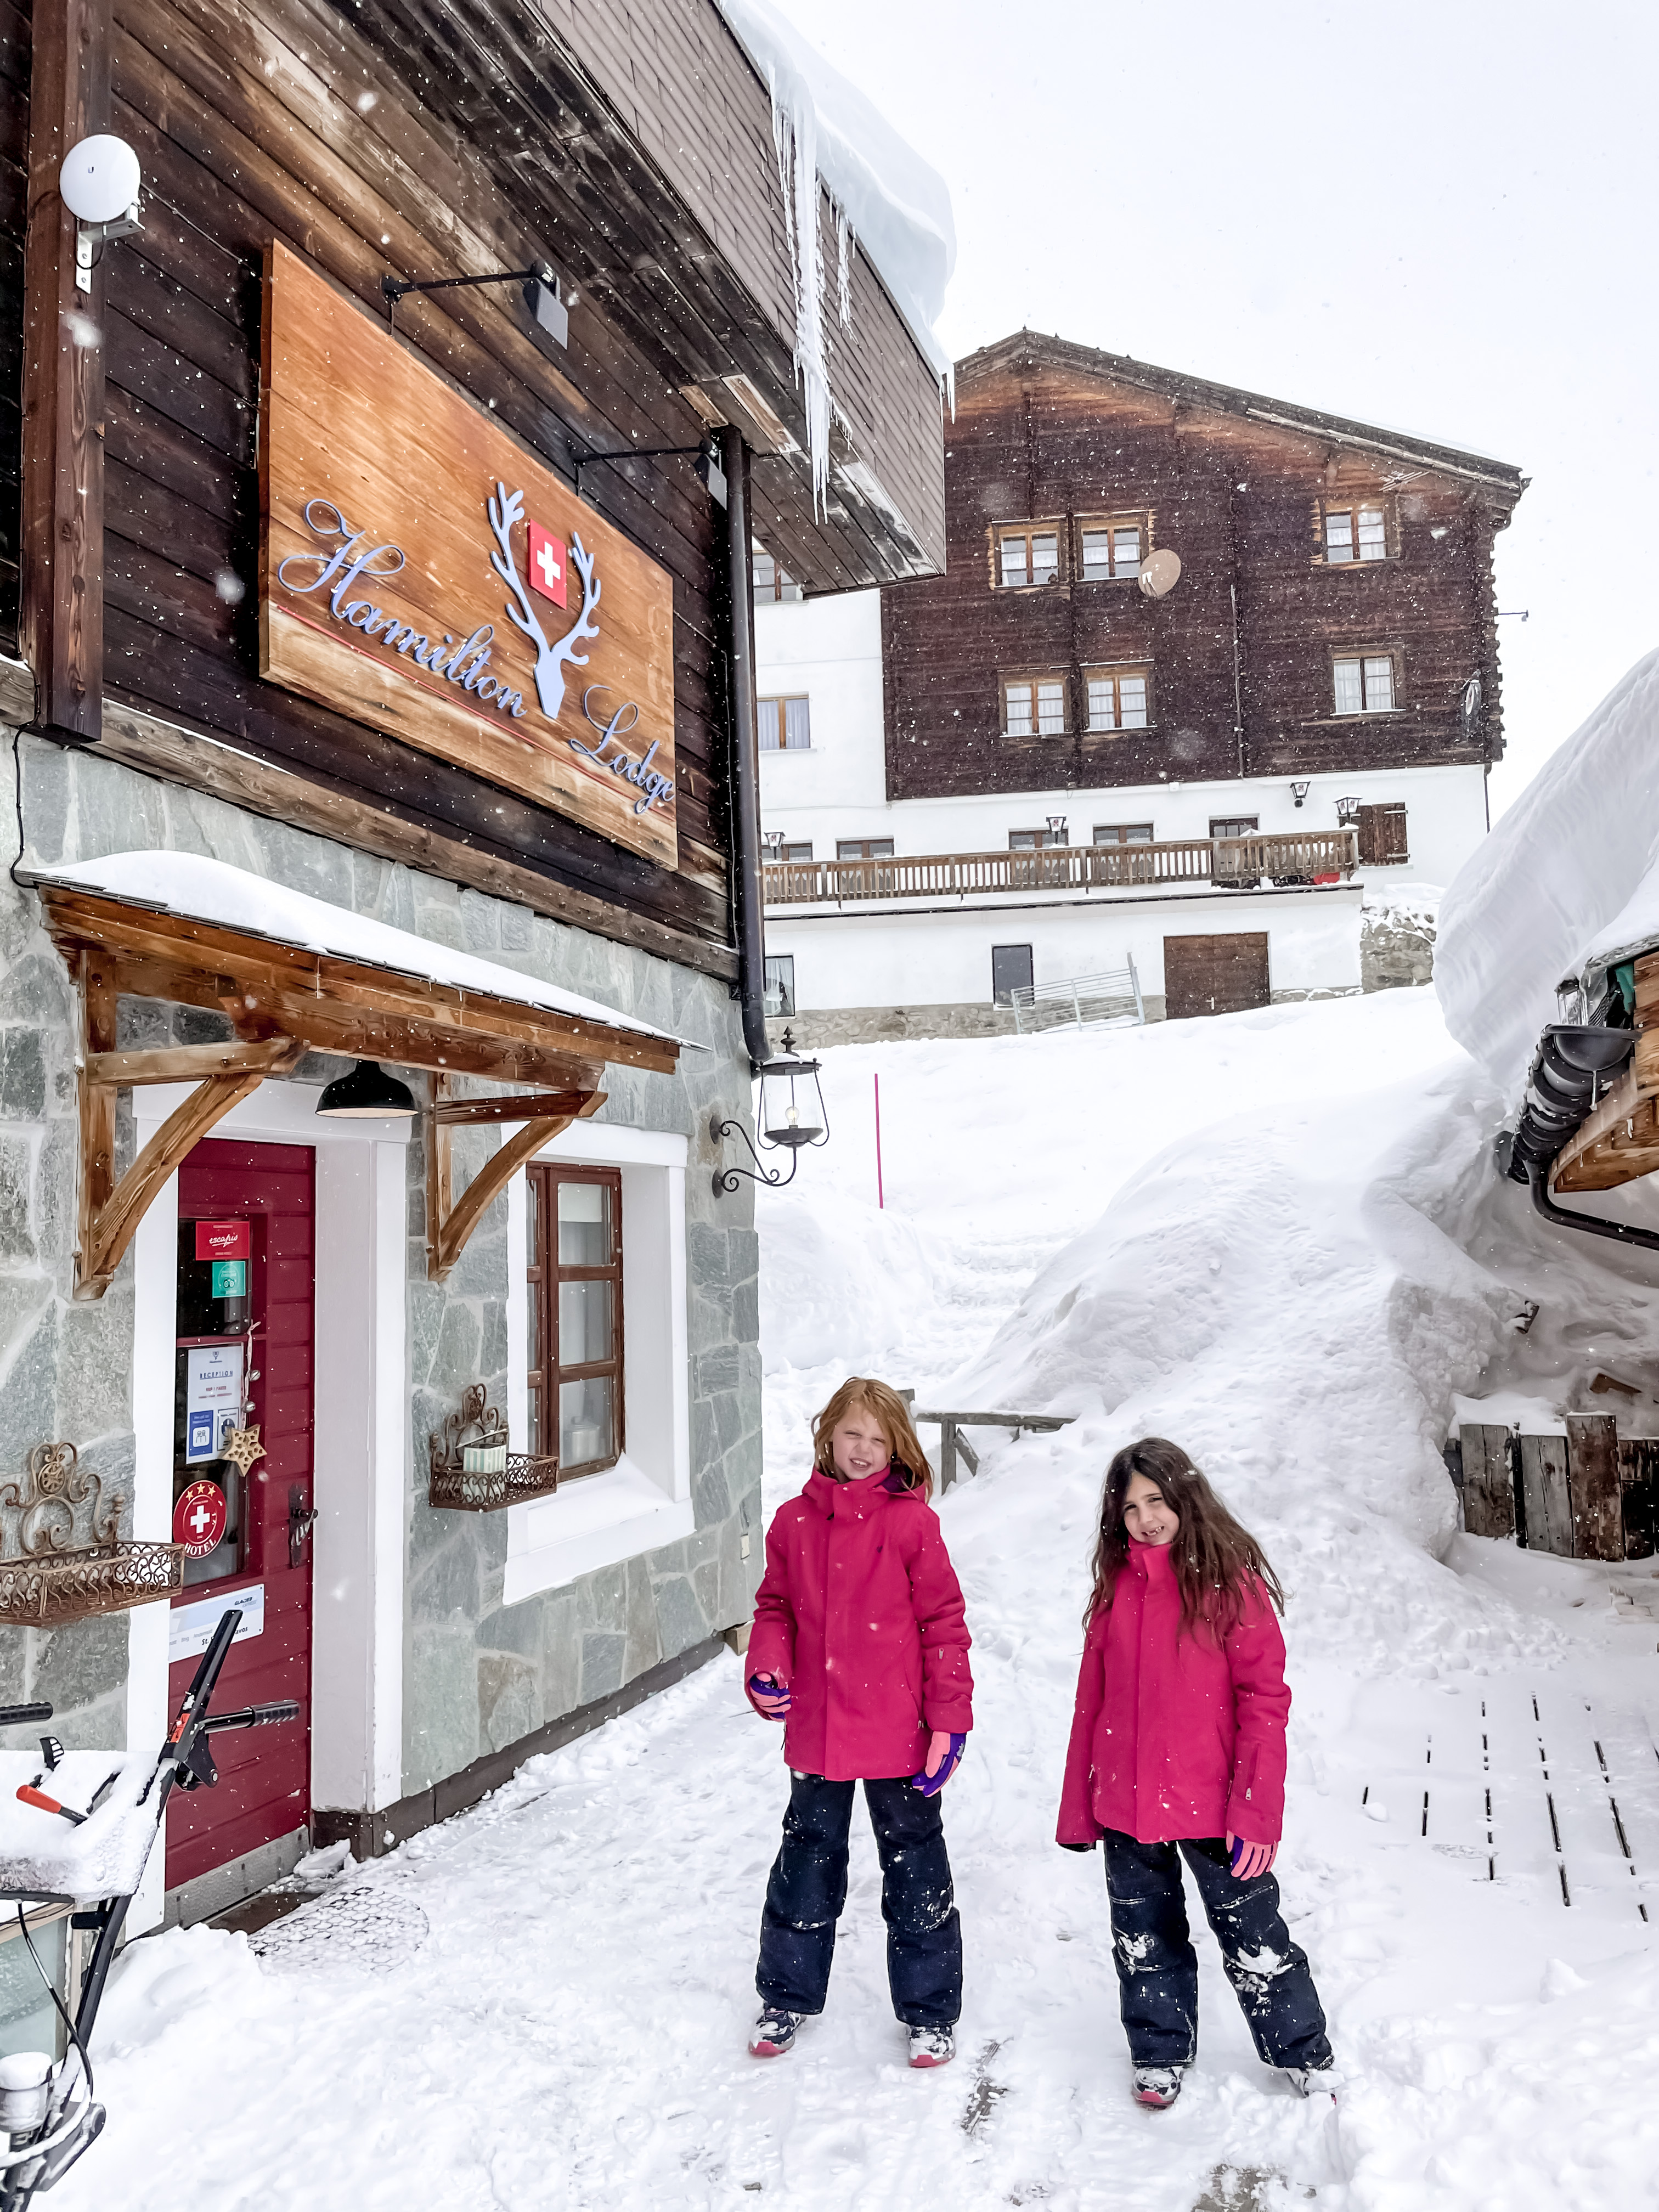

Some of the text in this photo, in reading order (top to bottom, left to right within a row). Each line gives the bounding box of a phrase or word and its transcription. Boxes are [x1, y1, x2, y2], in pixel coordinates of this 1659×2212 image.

[278, 498, 675, 814] Hamilton Lodge
[200, 1370, 233, 1379] RECEPTION
[184, 1538, 217, 1556] HOTEL
